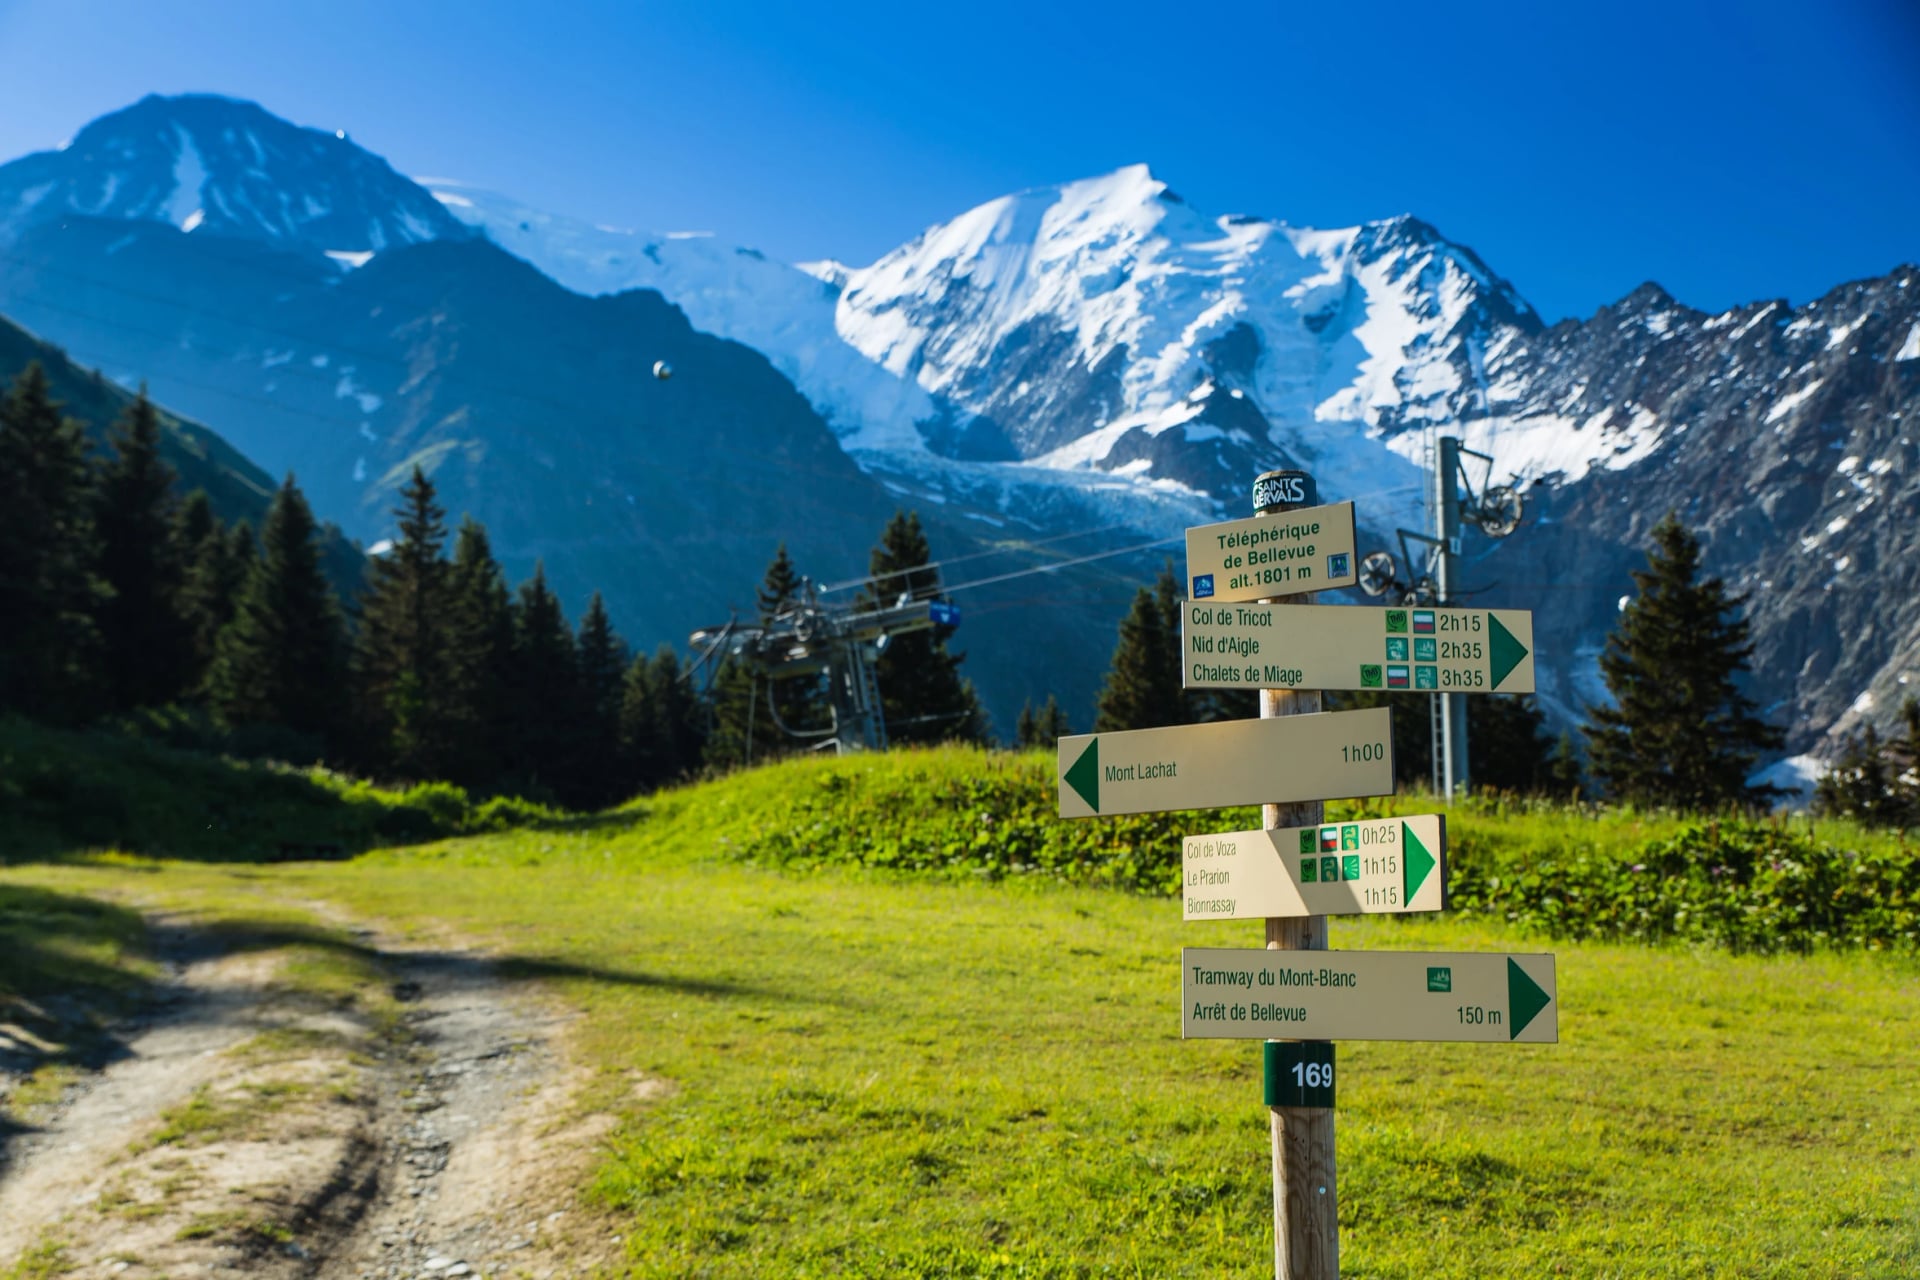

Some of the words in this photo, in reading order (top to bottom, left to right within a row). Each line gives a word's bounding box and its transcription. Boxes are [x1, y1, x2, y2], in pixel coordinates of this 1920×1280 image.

[1217, 522, 1320, 550] Téléphérique
[1223, 555, 1242, 569] de
[1248, 545, 1316, 566] Bellevue
[1230, 568, 1290, 589] alt.1801
[1298, 567, 1311, 579] m
[1192, 607, 1213, 625] Col
[1217, 609, 1232, 625] de
[1236, 609, 1272, 627] Tricot
[1440, 614, 1481, 632] 2h15
[1192, 636, 1213, 653] Nid
[1217, 637, 1260, 657] d'Aigle
[1441, 642, 1482, 659] 2h35
[1193, 664, 1240, 682] Chalets
[1245, 665, 1260, 682] de
[1264, 665, 1303, 686] Miage
[1442, 669, 1483, 687] 3h35
[1342, 743, 1384, 763] 1h00
[1105, 764, 1134, 782] Mont
[1138, 761, 1177, 780] Lachat
[1362, 825, 1396, 845] 0h25
[1187, 842, 1202, 859] Col
[1203, 841, 1214, 858] de
[1216, 840, 1236, 857] Voza
[1364, 855, 1396, 875] 1h15
[1187, 871, 1198, 887] Le
[1200, 868, 1230, 886] Prarion
[1187, 897, 1236, 915] Bionnassay
[1364, 887, 1397, 905] 1h15
[1192, 966, 1254, 989] Tramway
[1258, 967, 1275, 987] du
[1279, 968, 1357, 988] Mont-Blanc
[1193, 1002, 1227, 1021] Arrêt
[1230, 1003, 1246, 1021] de
[1251, 1003, 1307, 1022] Bellevue
[1457, 1006, 1484, 1025] 150
[1488, 1010, 1501, 1025] m
[1292, 1062, 1333, 1088] 169
